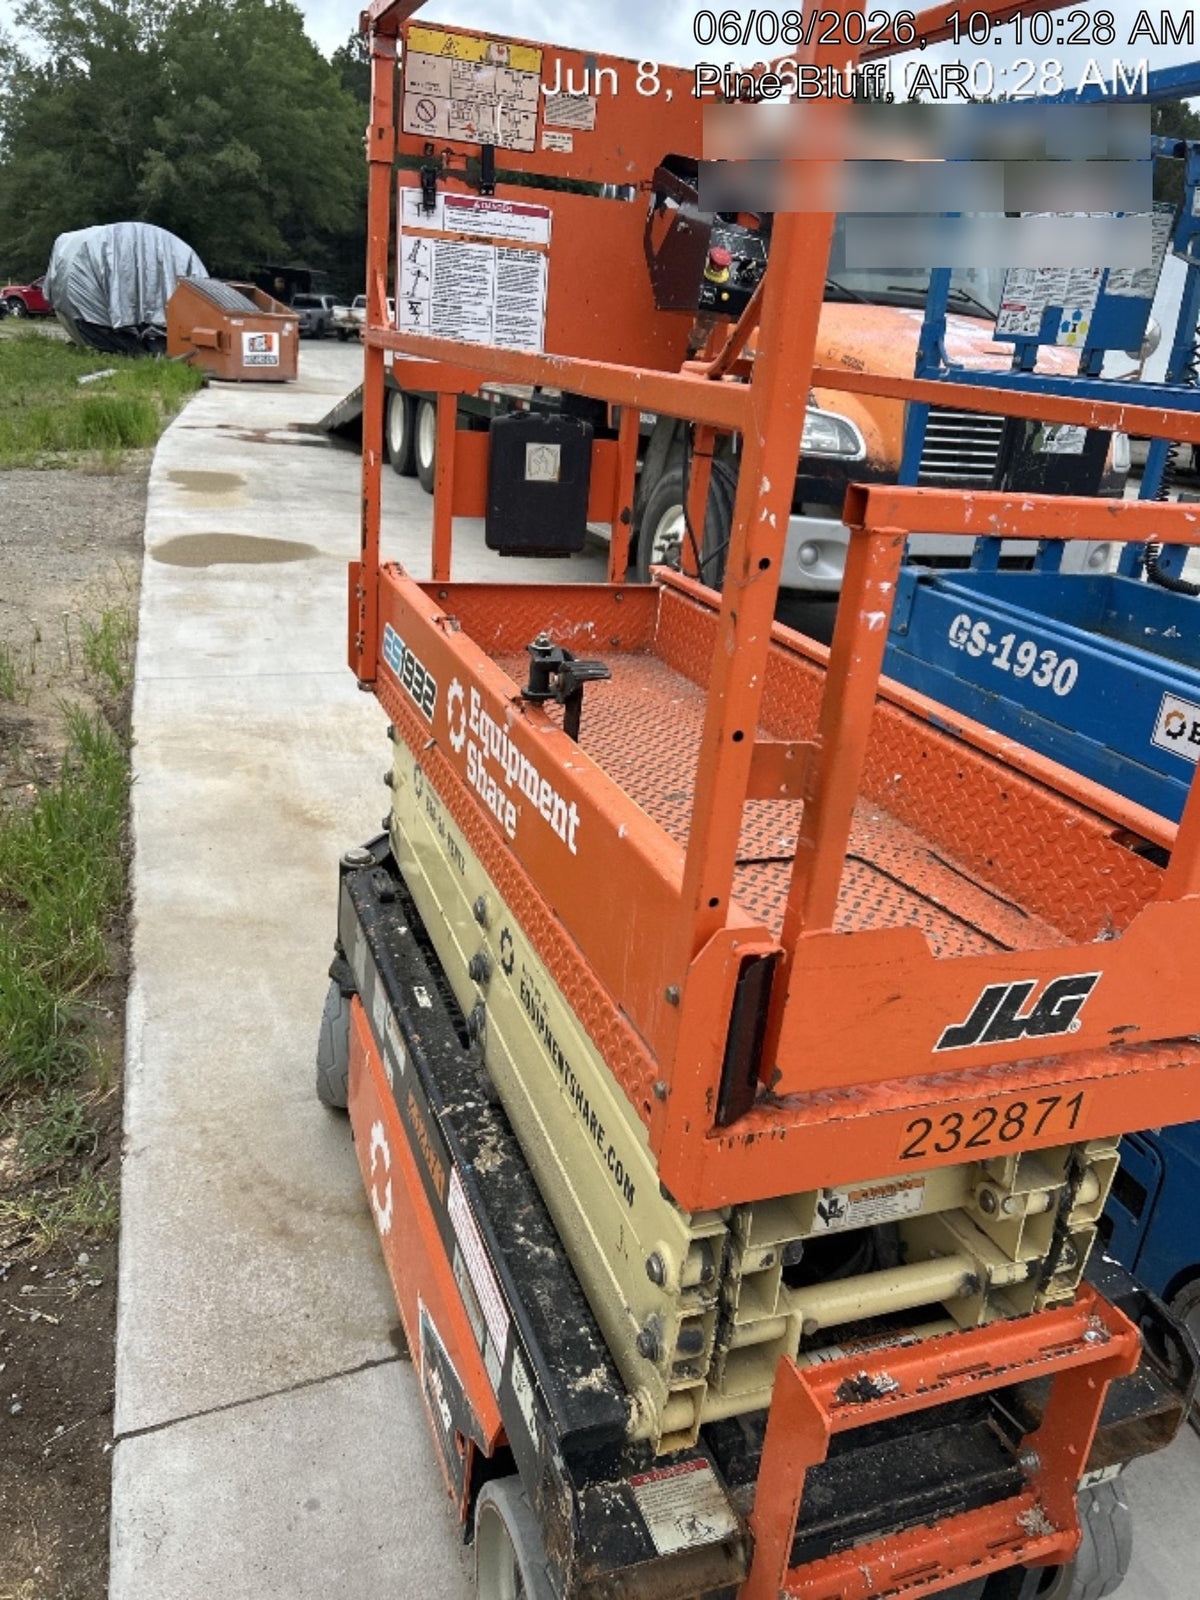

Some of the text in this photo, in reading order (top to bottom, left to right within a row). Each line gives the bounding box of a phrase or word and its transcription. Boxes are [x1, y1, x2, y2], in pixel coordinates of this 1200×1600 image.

[948, 613, 1078, 696] GS-1930
[467, 740, 517, 839] Share
[469, 686, 580, 855] Equipment
[520, 979, 635, 1208] EQUIPMENTSHARE.COM
[901, 1092, 1084, 1159] 232871
